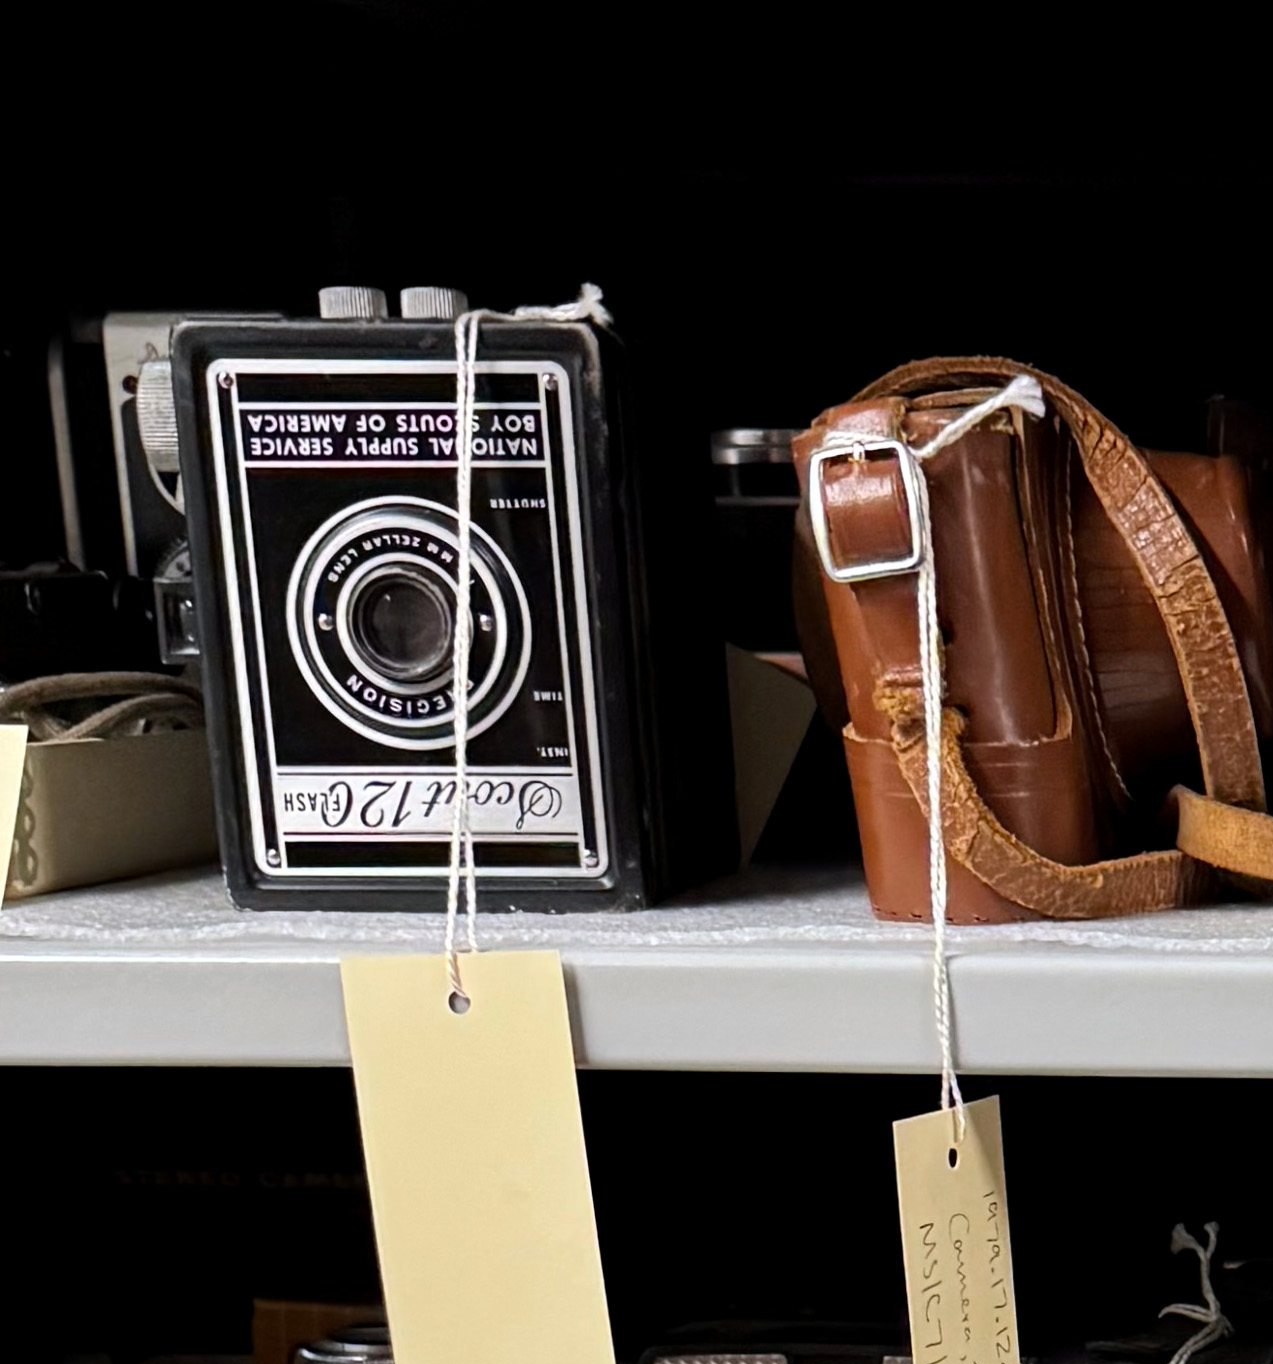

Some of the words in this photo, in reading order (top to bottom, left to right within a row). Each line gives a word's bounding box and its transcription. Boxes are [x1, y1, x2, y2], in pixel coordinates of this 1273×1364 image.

[247, 414, 346, 431] AMERICA
[357, 414, 385, 431] OF
[397, 414, 480, 431] SOUTS
[491, 414, 535, 432] BOY
[250, 437, 334, 456] SERVICE
[345, 438, 418, 456] SUPPLY
[431, 438, 538, 456] NATIOAL
[489, 498, 547, 509] SHUTTER
[533, 691, 564, 702] TIME
[284, 793, 341, 812] FLASH
